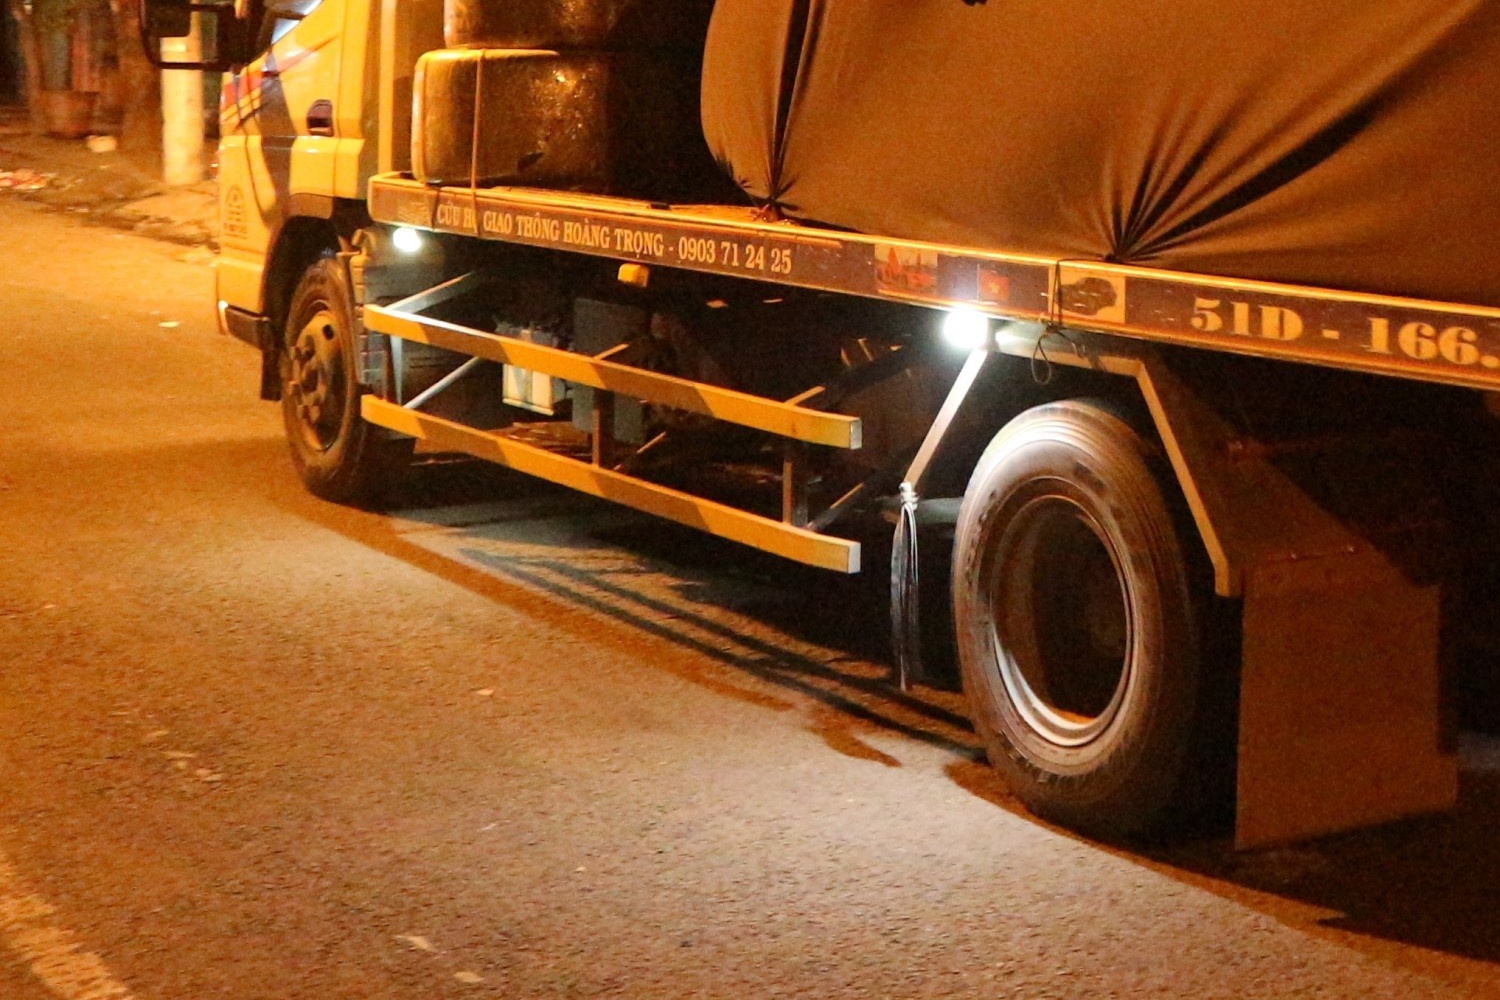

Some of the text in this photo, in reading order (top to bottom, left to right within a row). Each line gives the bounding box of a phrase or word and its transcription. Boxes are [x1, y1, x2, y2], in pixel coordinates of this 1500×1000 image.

[437, 202, 461, 226] CỨU
[483, 210, 512, 235] GIAO
[516, 211, 560, 242] THÔNG
[563, 217, 610, 250] HOÀNG
[614, 230, 664, 259] TRỌNG
[678, 236, 716, 264] 0903
[721, 241, 739, 267] 71
[745, 244, 765, 270] 24
[770, 247, 792, 275] 25
[1191, 297, 1303, 343] 51D
